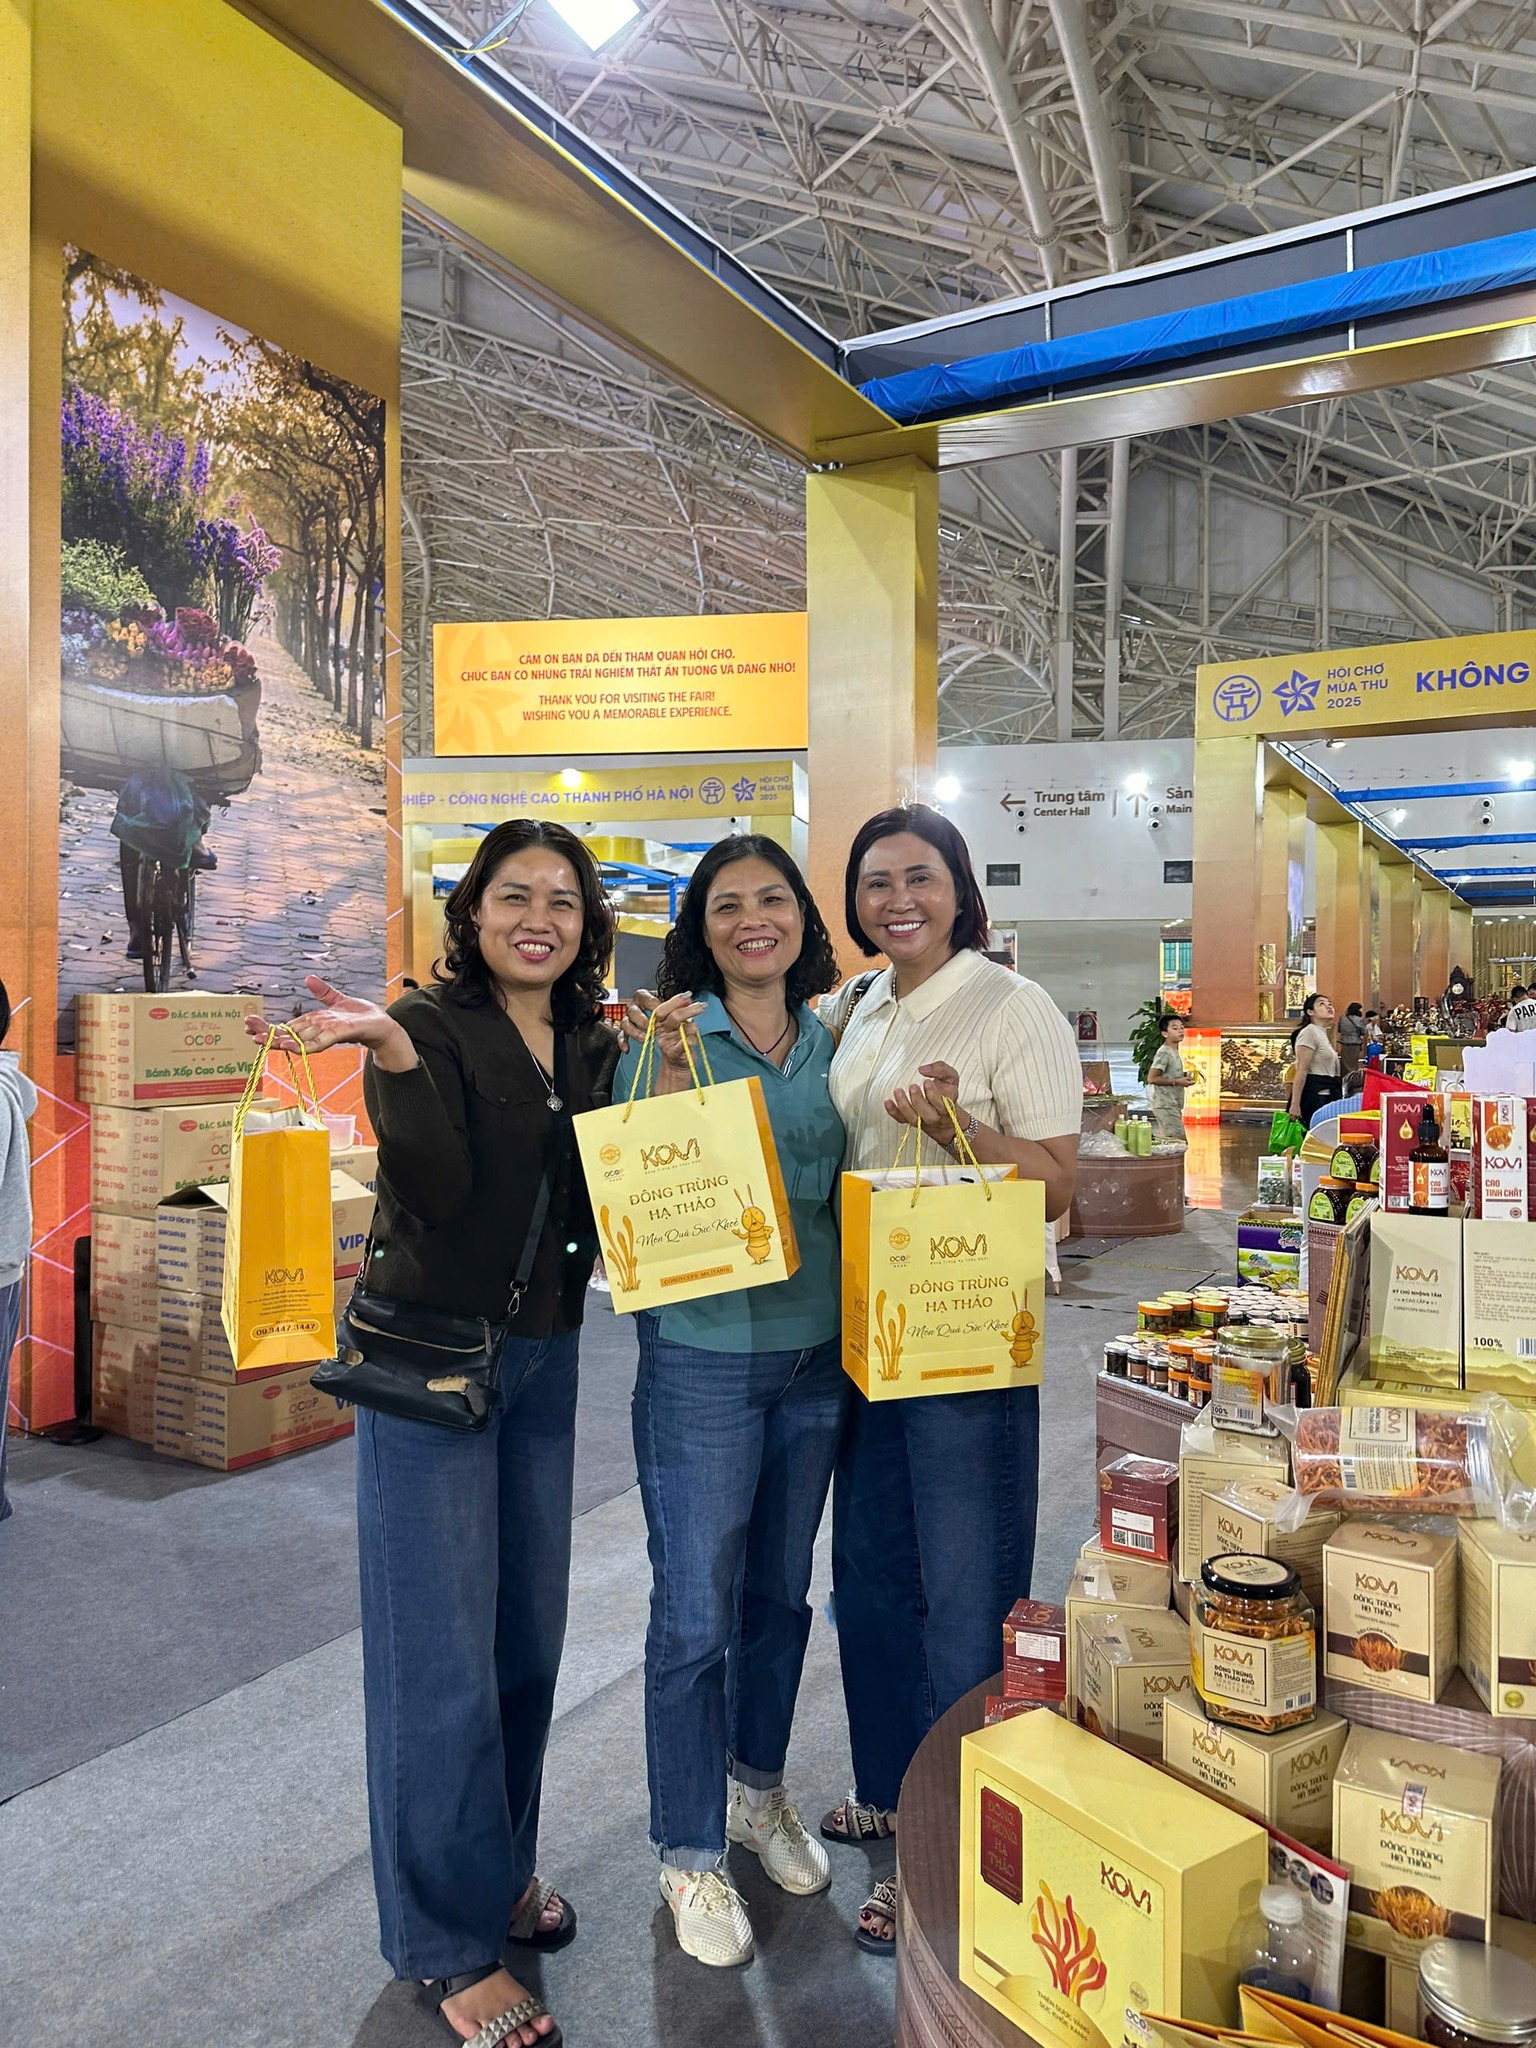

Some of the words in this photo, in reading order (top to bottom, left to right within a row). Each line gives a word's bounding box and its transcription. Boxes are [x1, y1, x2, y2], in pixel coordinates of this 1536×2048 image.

[625, 651, 654, 662] THAM
[656, 651, 686, 662] QUAN
[1327, 666, 1351, 680] HỘI
[1353, 662, 1385, 677] CHỢ
[1416, 661, 1530, 693] KHÔNG
[1327, 680, 1357, 694] MÙA
[1360, 678, 1389, 691] THU
[538, 694, 573, 705] THANK
[575, 693, 597, 704] YOU
[599, 693, 620, 704] FOR
[623, 692, 665, 703] VISITING
[667, 691, 687, 702] THE
[690, 690, 715, 702] FAIR!
[1327, 696, 1361, 709] 2025
[522, 709, 566, 721] WISHING
[568, 708, 591, 720] YOU
[593, 709, 601, 719] A
[603, 707, 667, 719] MEMORABLE
[669, 706, 732, 718] EXPERIENCE.
[448, 791, 488, 805] CÔNG
[491, 791, 528, 807] NGHỆ
[531, 792, 560, 804] CAO
[564, 788, 611, 804] THÀNH
[614, 785, 643, 802] PHỐ
[646, 786, 666, 801] HÀ
[669, 785, 693, 802] NỘI
[1034, 791, 1075, 805] Trung
[1078, 789, 1105, 802] tâm
[1033, 806, 1067, 817] Center
[1069, 805, 1090, 816] Hall
[1165, 804, 1192, 814] Main
[211, 1009, 223, 1018] HÀ
[225, 1009, 241, 1019] NỘI
[1514, 1003, 1536, 1020] PAR
[184, 1034, 222, 1046] OCOP
[145, 1067, 171, 1078] Bánh
[173, 1065, 192, 1079] Xốp
[195, 1066, 215, 1077] Cao
[216, 1063, 236, 1077] Cấp
[1393, 1102, 1420, 1114] KOVI
[640, 1137, 701, 1171] KOVI
[1485, 1156, 1522, 1170] KOVI
[629, 1187, 673, 1206] ĐÔNG
[676, 1174, 729, 1195] TRÙNG
[1485, 1179, 1500, 1188] CAO
[1485, 1188, 1503, 1198] TINH
[648, 1207, 671, 1222] HẠ
[674, 1195, 717, 1215] THẢO
[338, 1233, 365, 1251] VIP
[635, 1233, 665, 1248] Món
[930, 1233, 988, 1261] KOVI
[264, 1267, 305, 1286] KOVI
[1396, 1265, 1439, 1283] KOVI
[909, 1279, 954, 1295] ĐÔNG
[957, 1274, 1009, 1291] TRÙNG
[925, 1300, 948, 1314] HẠ
[952, 1293, 993, 1310] THẢO
[906, 1324, 935, 1339] Món
[1473, 1337, 1503, 1349] 100%
[288, 1397, 320, 1414] OCOP
[1212, 1405, 1228, 1415] 100%
[1218, 1515, 1243, 1540] KOVI
[1221, 1558, 1259, 1570] KOVI
[1355, 1572, 1398, 1595] KOVI
[1353, 1593, 1374, 1605] ĐÔNG
[1376, 1598, 1401, 1612] TRÙNG
[1213, 1643, 1253, 1666] KOVI
[1214, 1664, 1231, 1675] ĐÔNG
[1232, 1668, 1253, 1680] TRÙNG
[1224, 1673, 1241, 1683] THẢO
[1241, 1676, 1255, 1686] KHÔ
[1192, 1729, 1236, 1767] KOVI
[1290, 1744, 1329, 1776] KOVI
[1192, 1756, 1211, 1776] ĐÔNG
[1212, 1766, 1236, 1787] TRÙNG
[1380, 1808, 1443, 1842] KOVI
[1380, 1839, 1407, 1856] ĐÔNG
[1410, 1846, 1444, 1864] TRÙNG
[1100, 1860, 1152, 1915] KOVI
